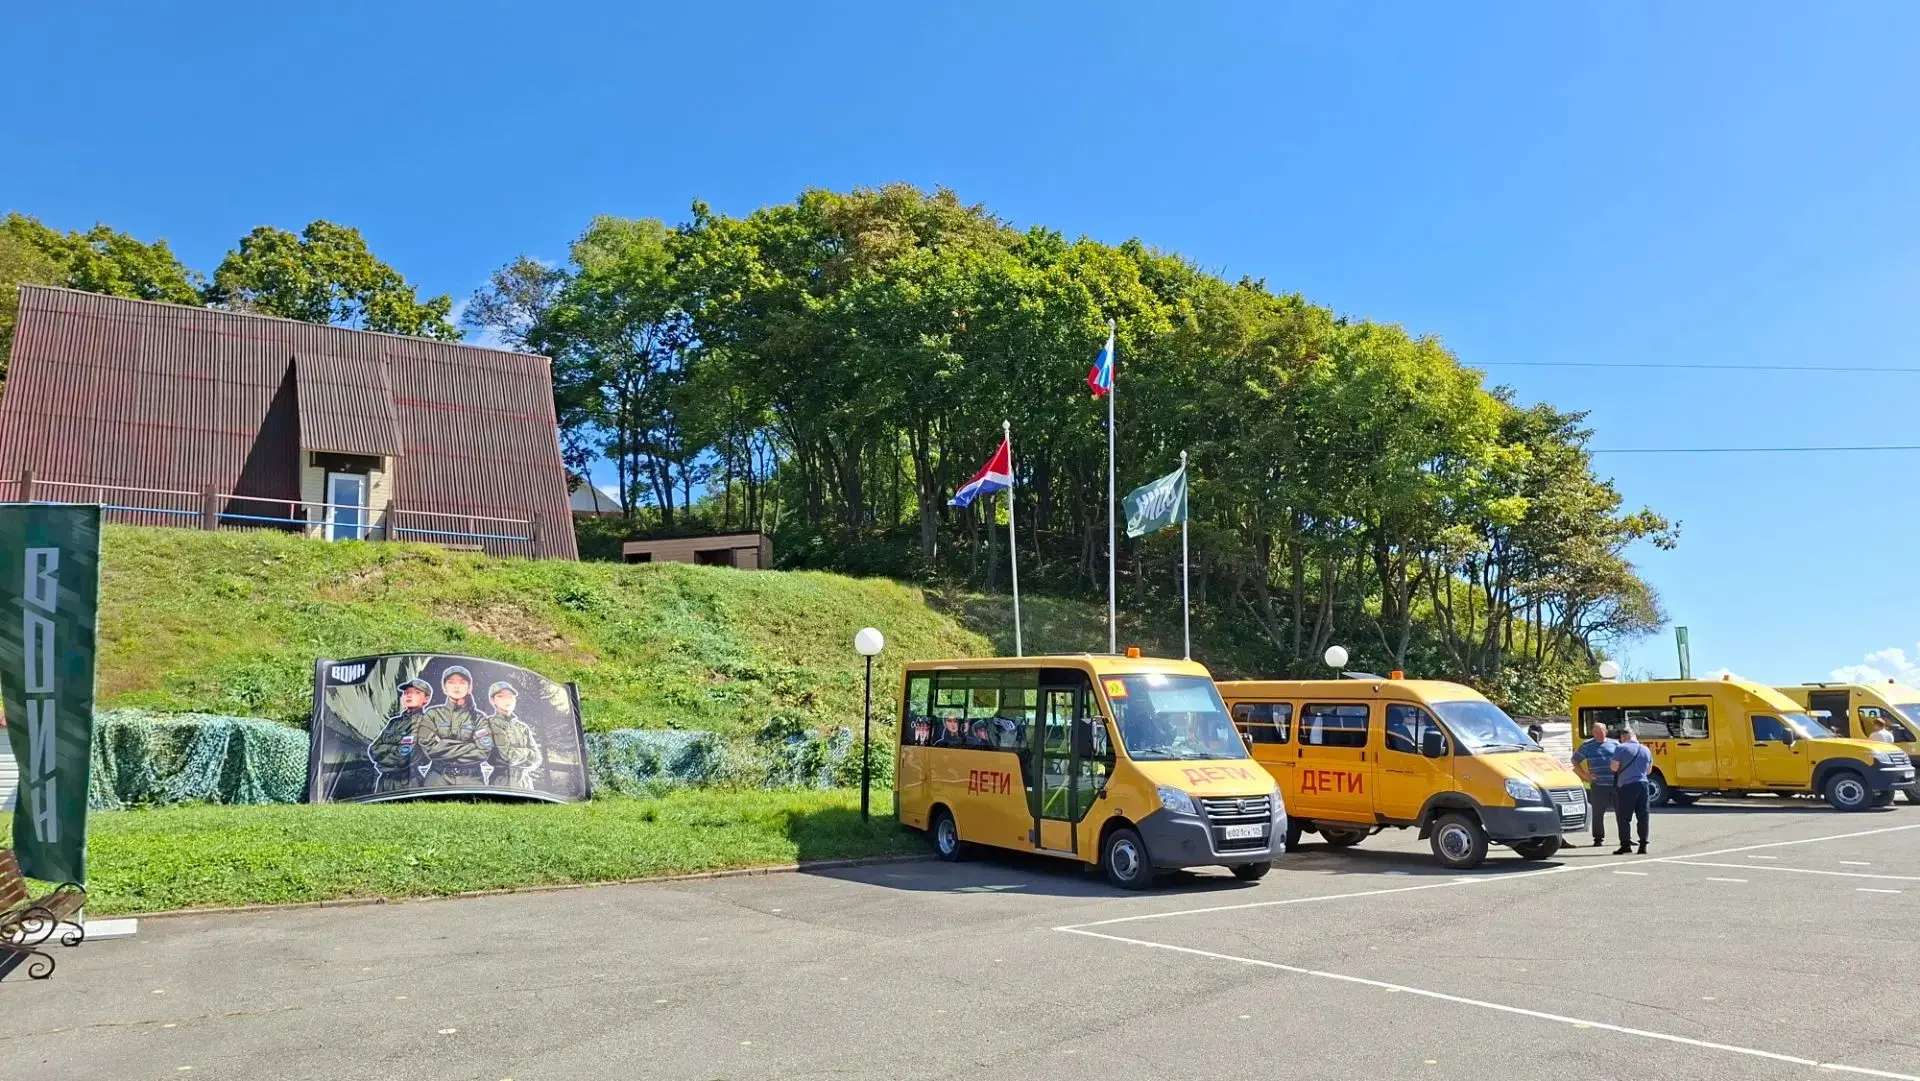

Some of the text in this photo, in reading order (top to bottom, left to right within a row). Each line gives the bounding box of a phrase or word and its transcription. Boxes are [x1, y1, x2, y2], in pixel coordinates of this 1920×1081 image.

[331, 663, 366, 683] ВОИН
[23, 547, 60, 843] ВОИН
[1643, 741, 1667, 755] ТИ
[968, 769, 1011, 796] ДЕТИ
[1182, 766, 1256, 786] ДЕТИ
[1301, 769, 1363, 795] ДЕТИ
